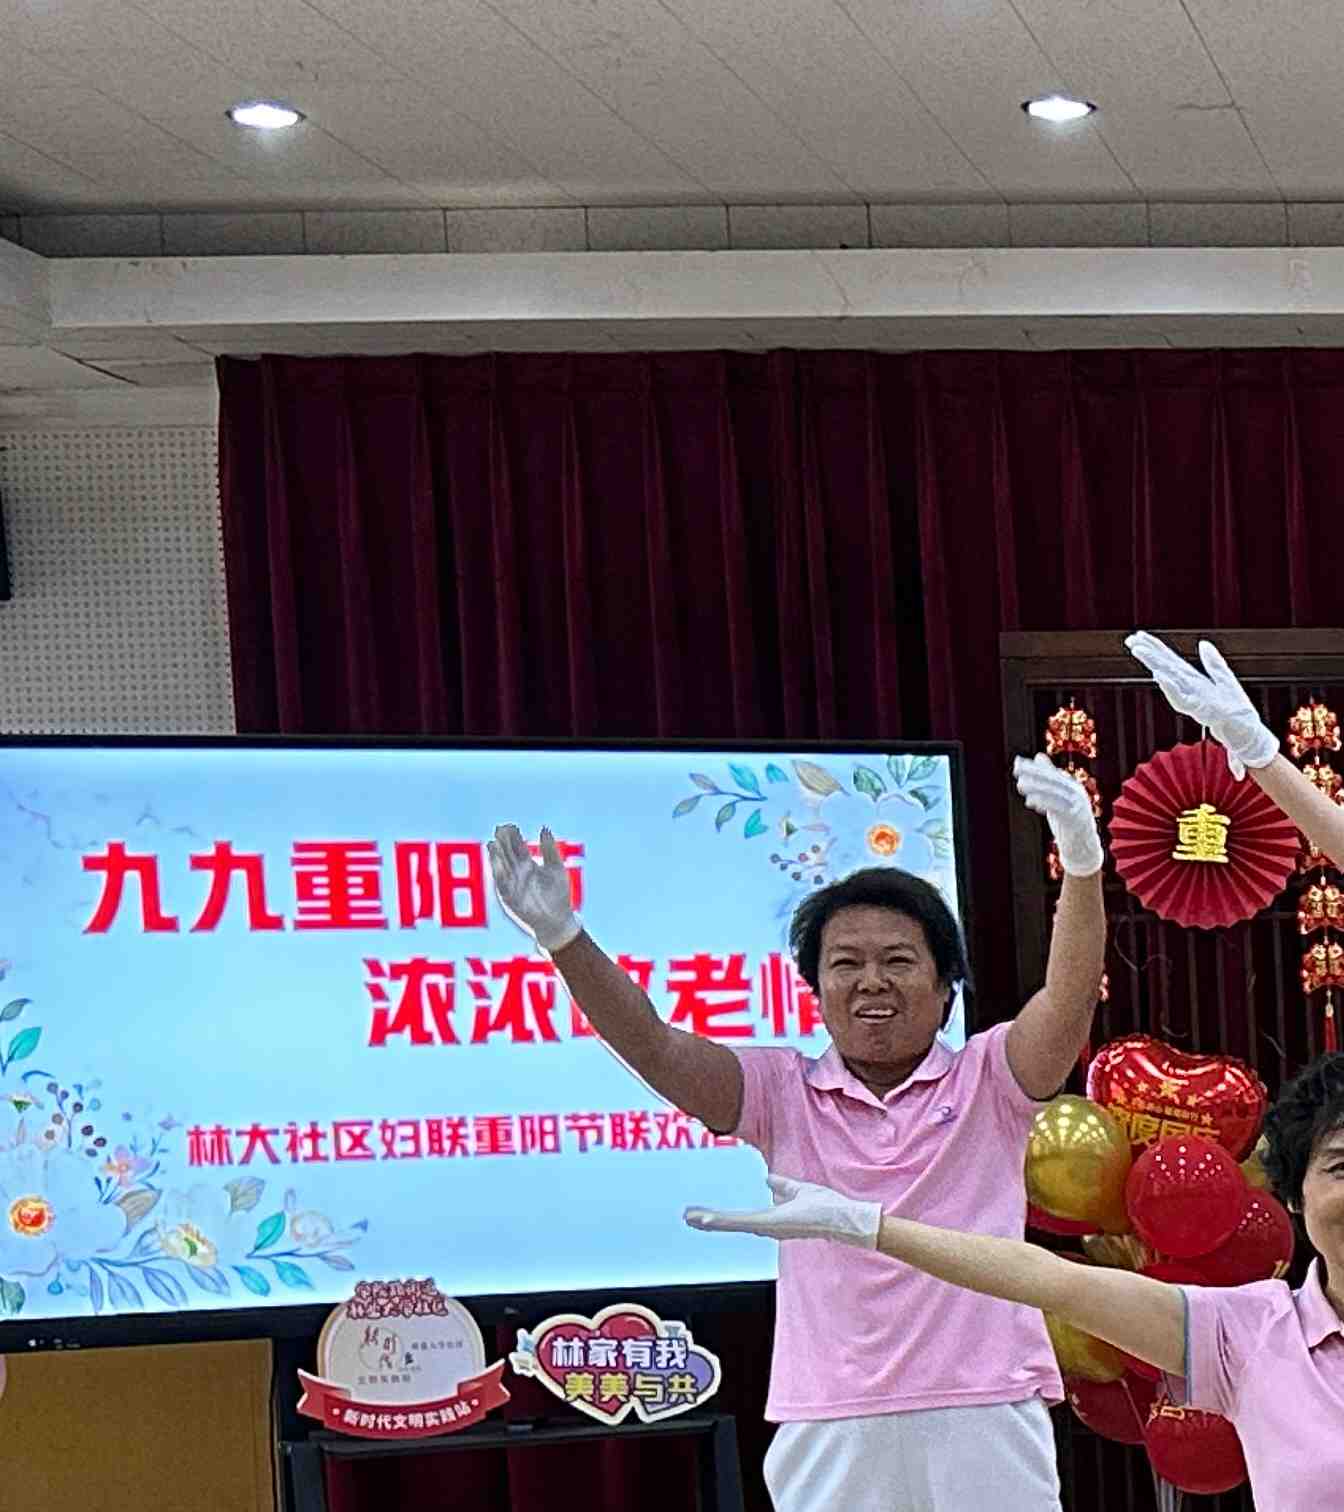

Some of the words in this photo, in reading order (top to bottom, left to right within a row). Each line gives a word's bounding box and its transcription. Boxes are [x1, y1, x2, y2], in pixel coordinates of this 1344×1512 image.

[1172, 803, 1231, 864] 重
[552, 1337, 688, 1368] 林家有我
[565, 1372, 698, 1403] 美美与共
[343, 1401, 472, 1430] 新时代文明实践站
